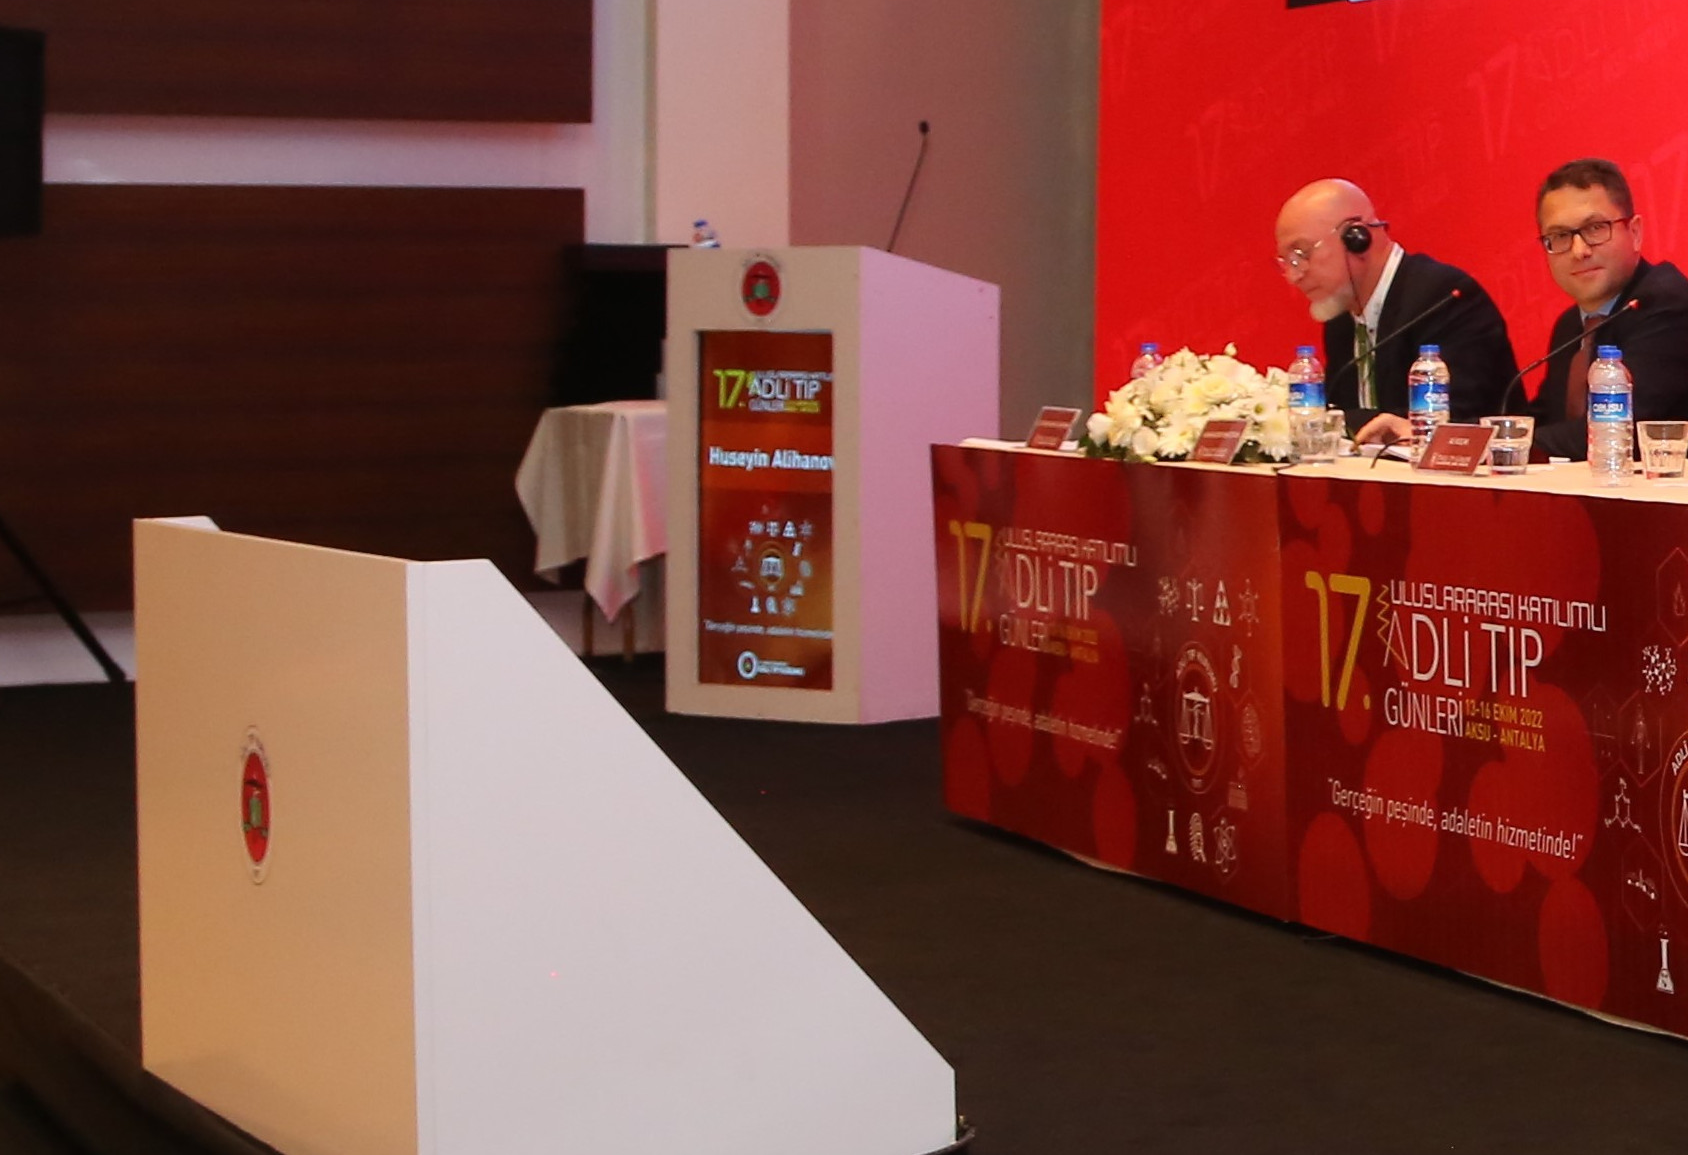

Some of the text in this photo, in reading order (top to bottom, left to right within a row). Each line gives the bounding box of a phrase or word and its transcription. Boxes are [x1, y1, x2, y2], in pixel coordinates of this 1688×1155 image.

[713, 369, 746, 408] 17.
[793, 378, 821, 400] TIP
[709, 446, 770, 471] Huseyin
[1058, 560, 1099, 621] TIP
[1390, 579, 1607, 633] ULUSLARARASI KATILIMLI
[1305, 570, 1371, 711] 17.
[1377, 610, 1543, 698] ADLİ TIP
[1384, 688, 1464, 739] GÜNLERİ
[1520, 708, 1543, 730] 2022
[1465, 723, 1545, 753] AKSU ANTALYA
[1440, 809, 1493, 843] adaletin
